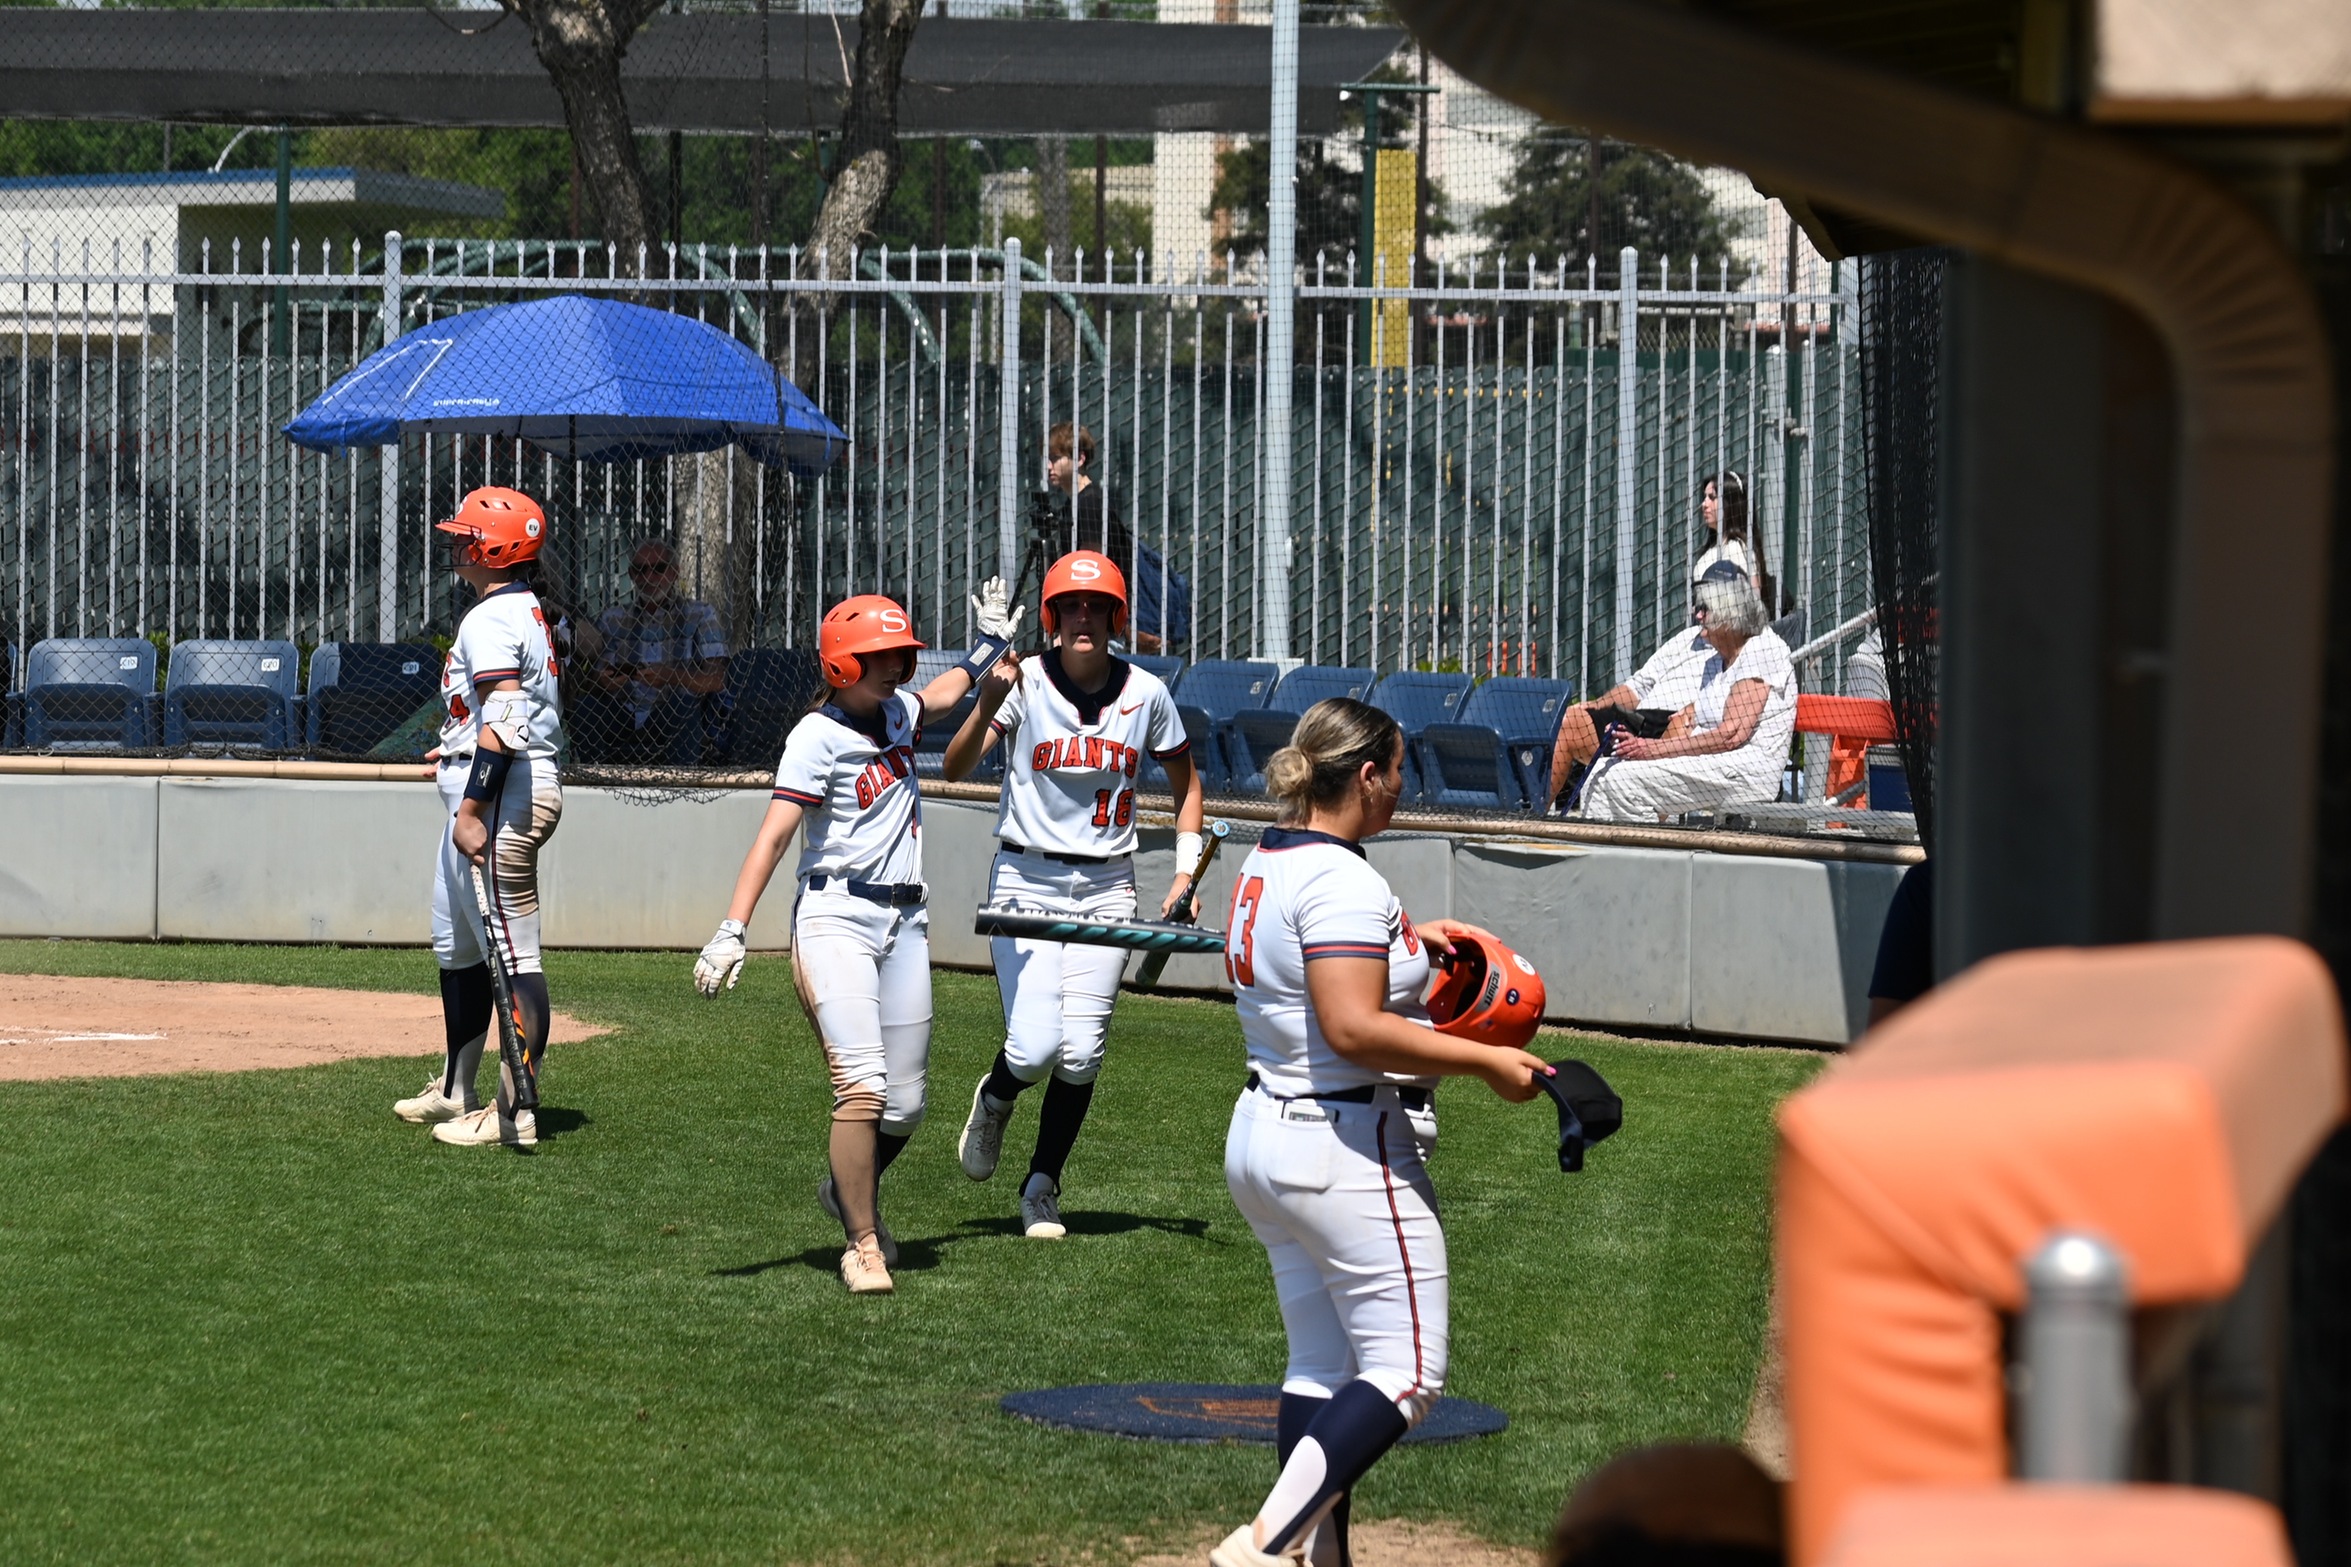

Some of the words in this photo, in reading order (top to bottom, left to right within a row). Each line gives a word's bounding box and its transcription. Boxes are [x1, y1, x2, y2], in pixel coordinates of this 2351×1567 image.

[1070, 558, 1101, 580] S
[879, 609, 907, 633] S
[1032, 735, 1138, 779] GIANTS
[855, 745, 917, 810] GIANT
[1091, 788, 1134, 827] 16
